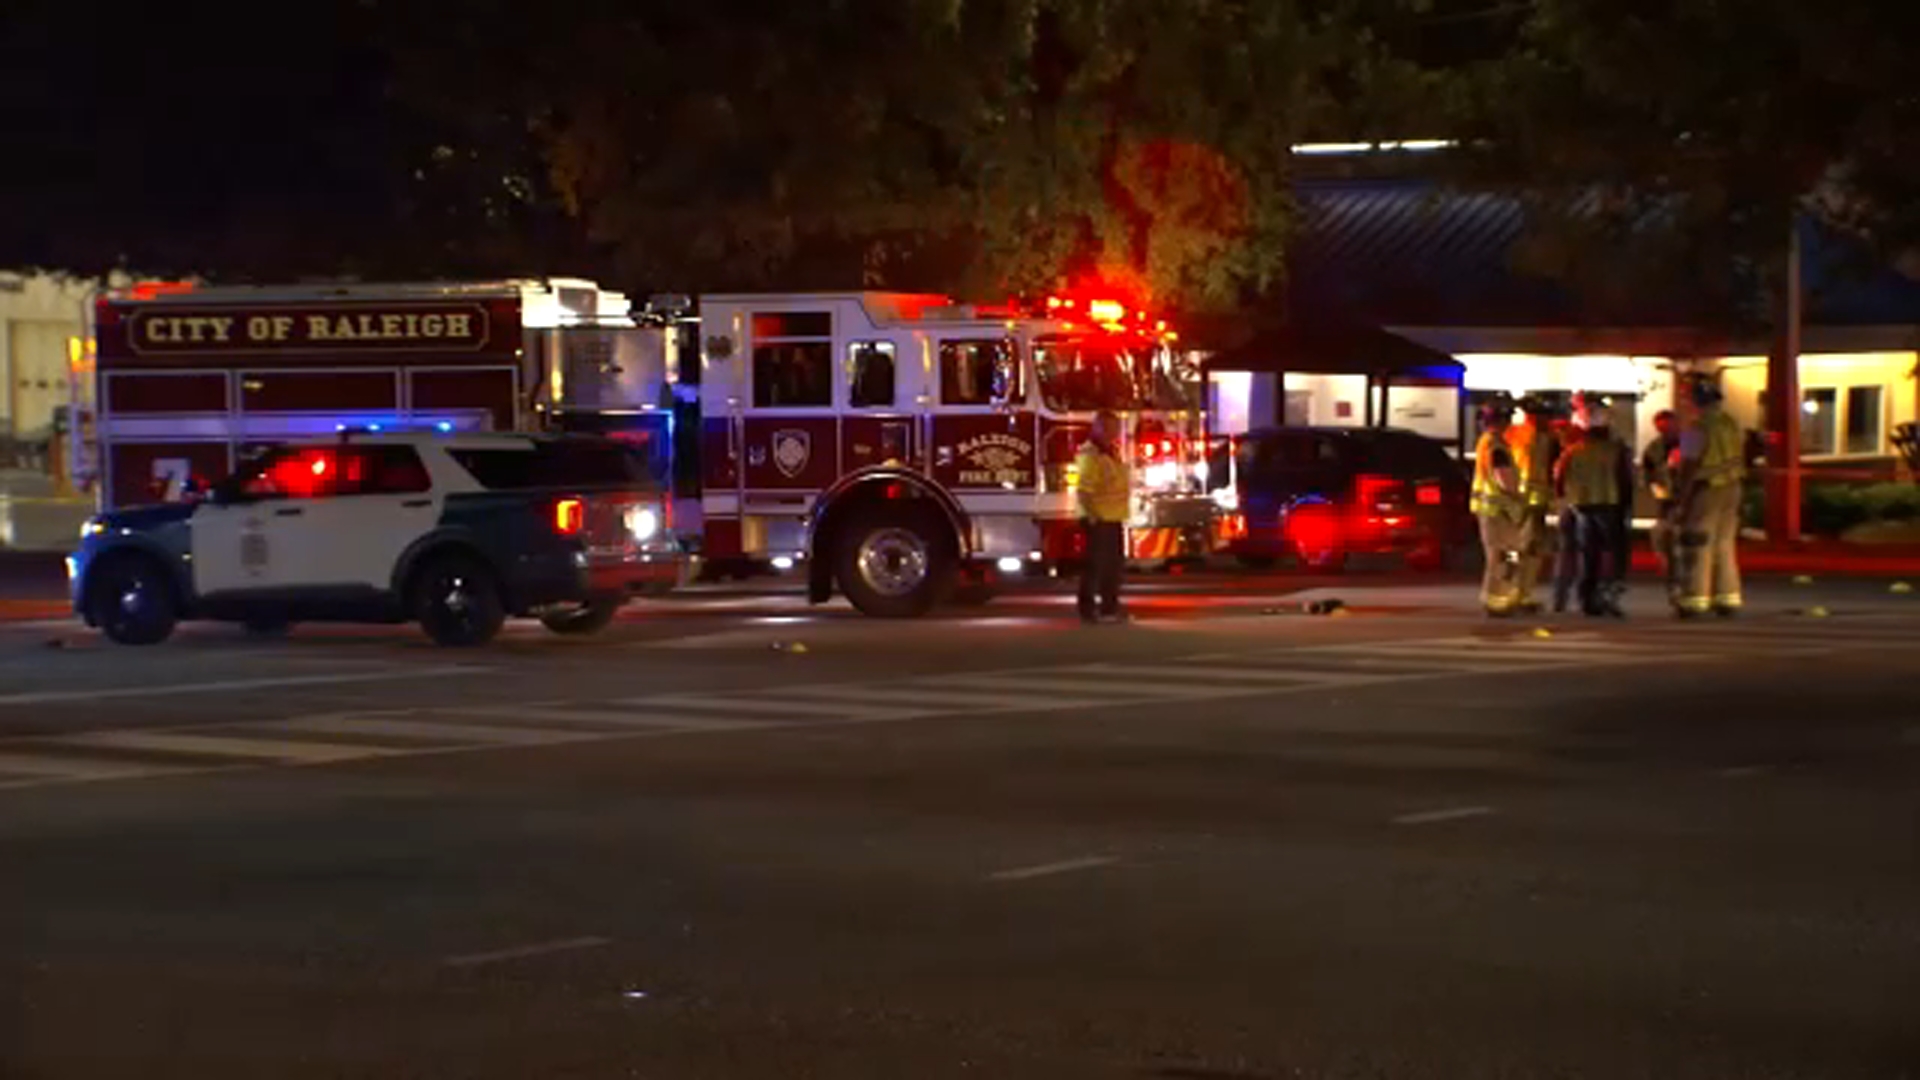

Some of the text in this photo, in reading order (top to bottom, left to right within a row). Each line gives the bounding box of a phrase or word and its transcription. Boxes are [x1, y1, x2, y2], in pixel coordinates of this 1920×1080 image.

[146, 312, 472, 341] CITY OF RALEIGH
